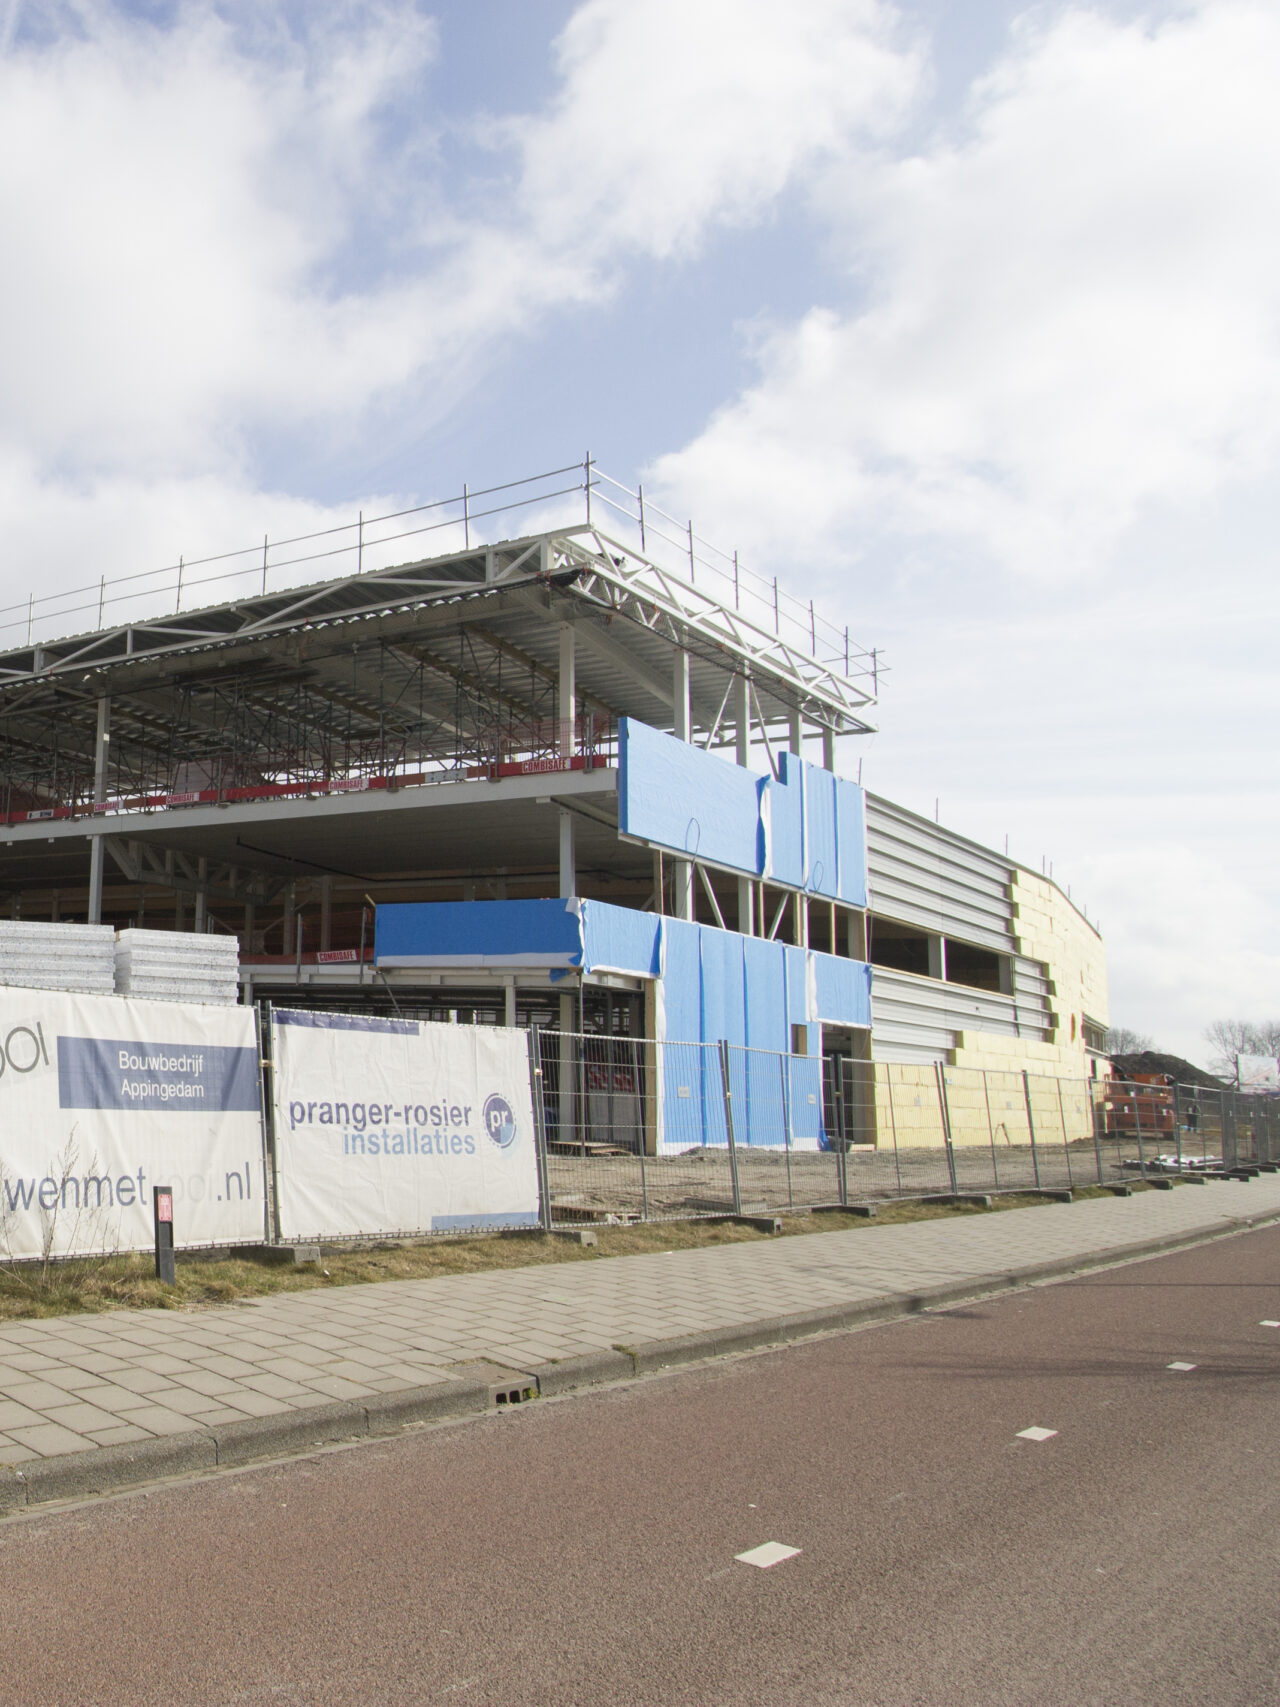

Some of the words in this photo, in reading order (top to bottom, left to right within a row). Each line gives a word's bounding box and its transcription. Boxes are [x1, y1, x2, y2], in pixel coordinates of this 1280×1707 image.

[523, 759, 567, 772] COMBISAFE
[119, 1051, 204, 1073] Bouwbedrijf
[121, 1080, 205, 1101] Appingedam
[289, 1099, 472, 1132] pranger-rosier
[490, 1108, 508, 1129] pr
[343, 1126, 476, 1156] installaties
